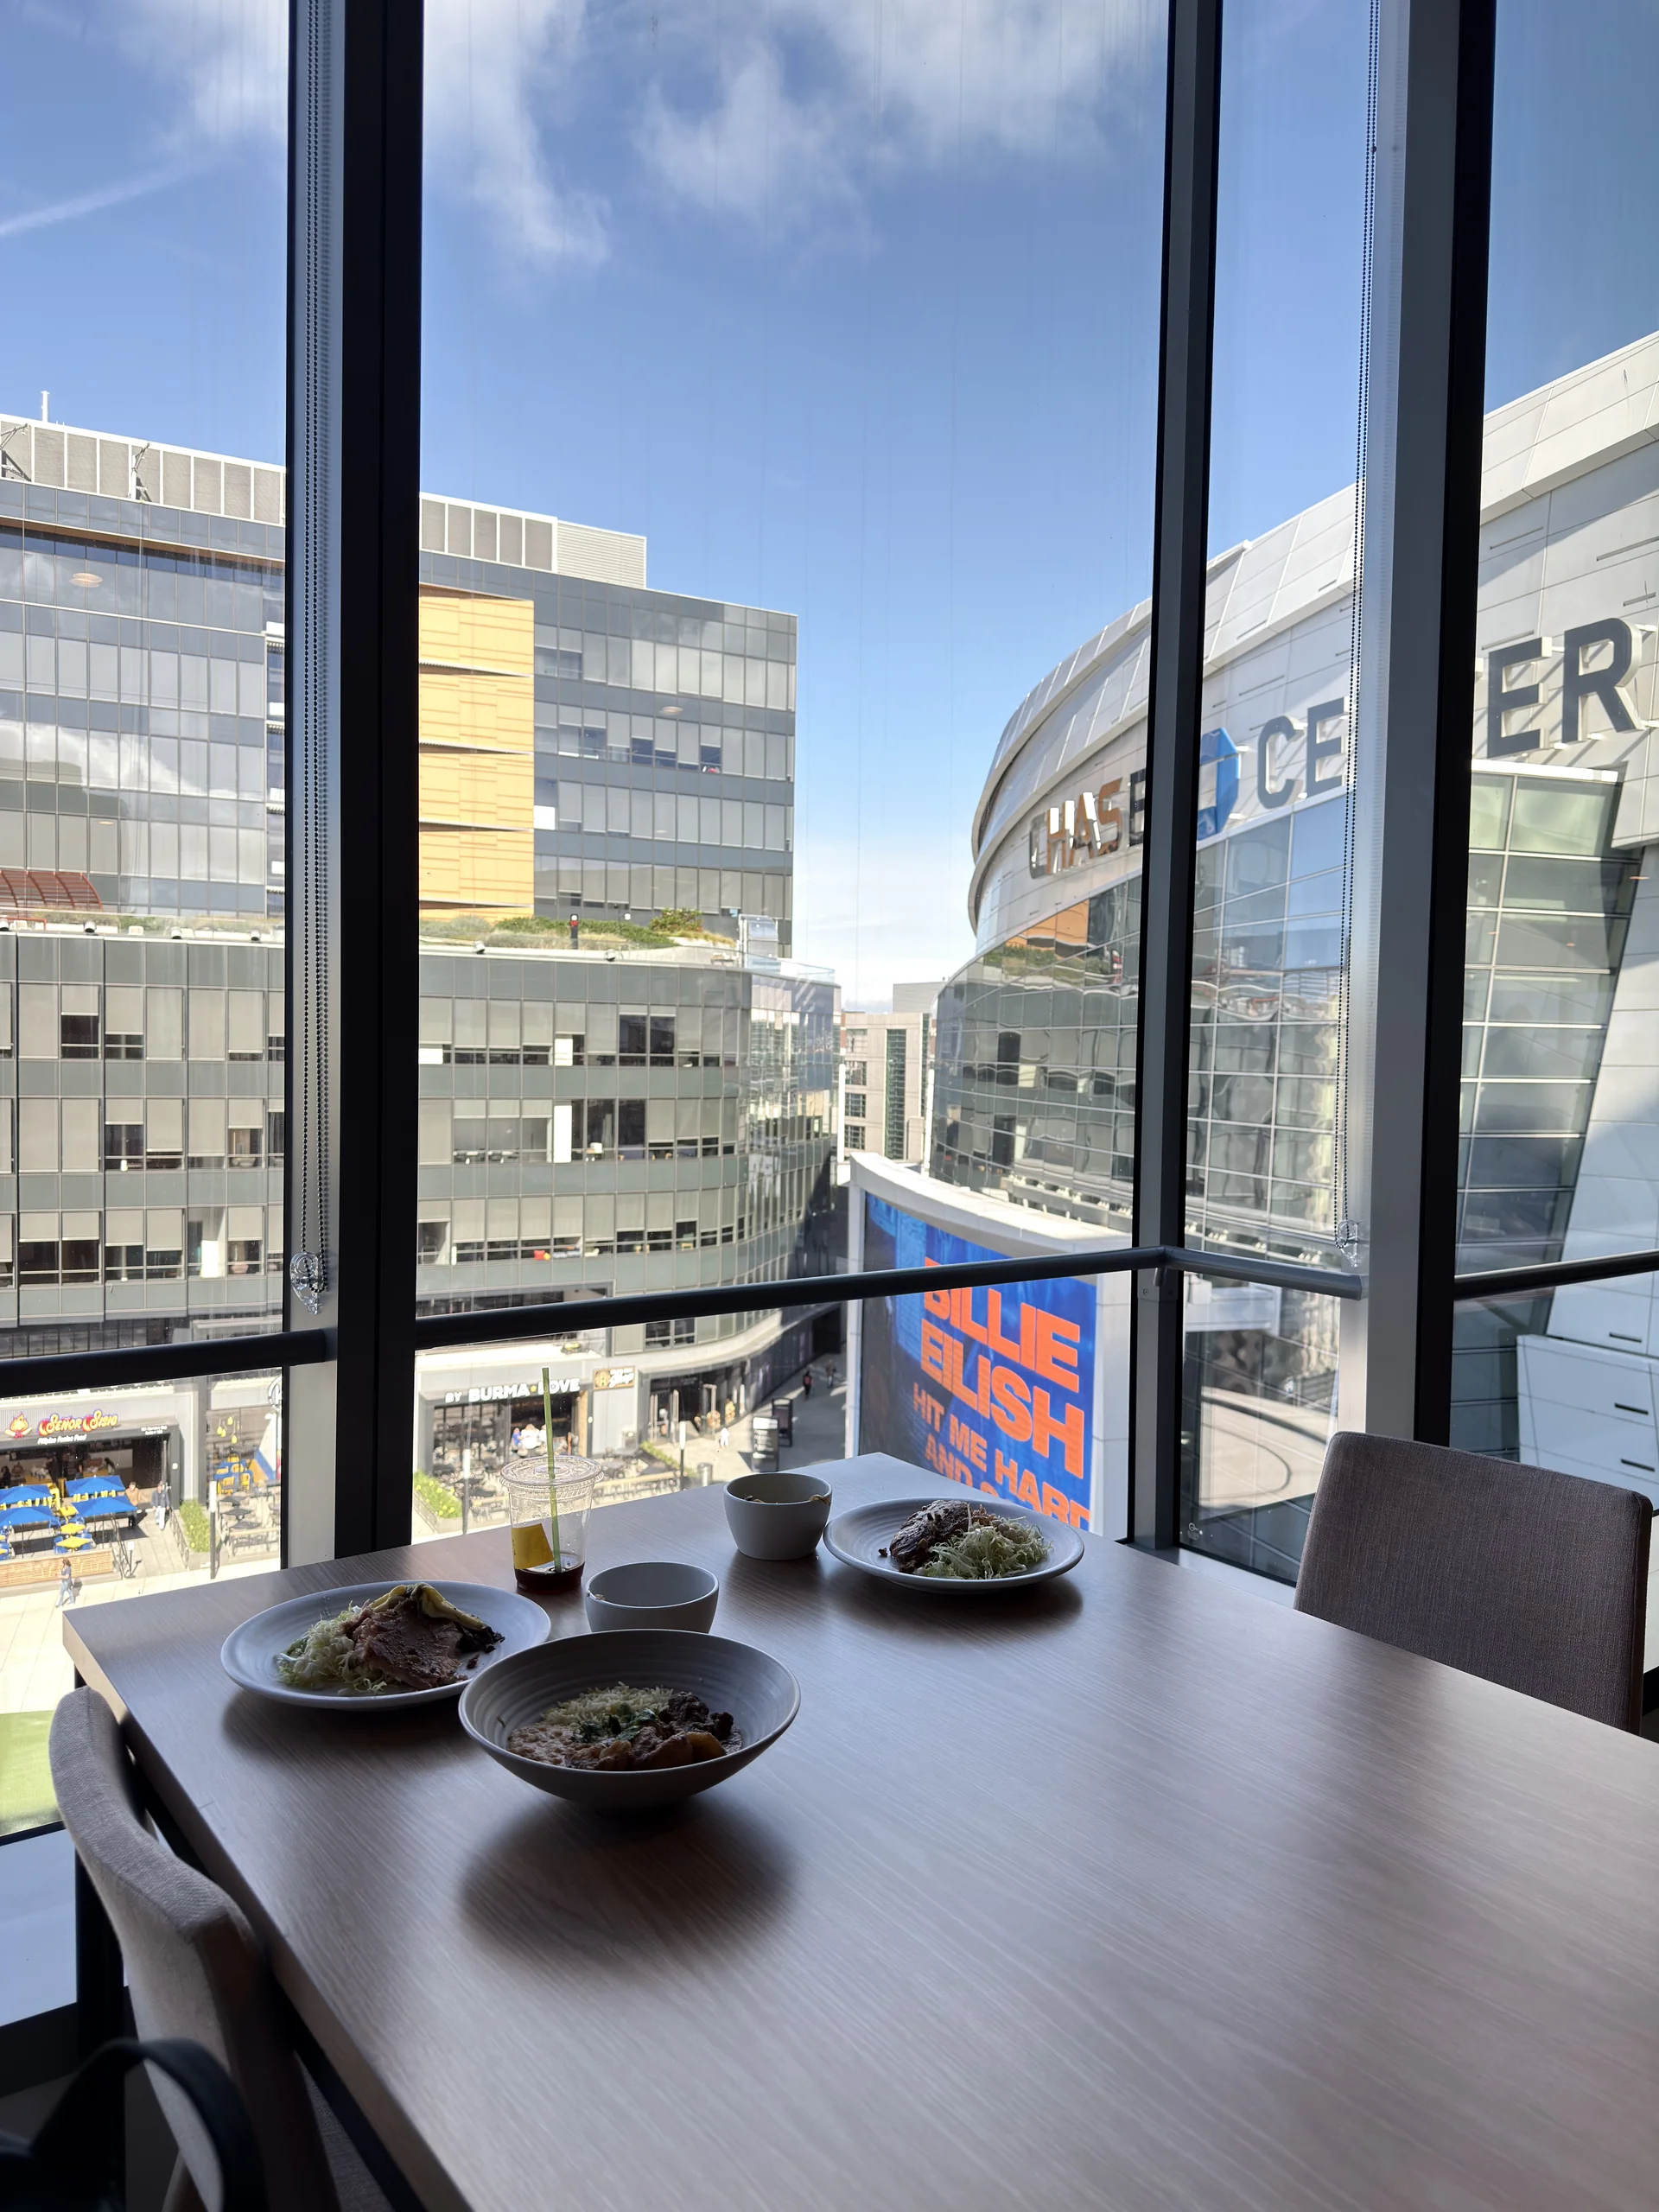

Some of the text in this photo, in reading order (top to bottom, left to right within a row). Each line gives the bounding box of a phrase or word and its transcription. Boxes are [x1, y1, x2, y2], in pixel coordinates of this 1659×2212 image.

[1029, 768, 1147, 880] CHASE
[924, 1256, 1080, 1394] BILLIE
[444, 1390, 463, 1404] BY
[467, 1383, 531, 1402] BURMA
[912, 1382, 945, 1433] HIT
[950, 1414, 988, 1473] ME
[920, 1317, 1085, 1480] EILISH
[925, 1433, 974, 1488] AND
